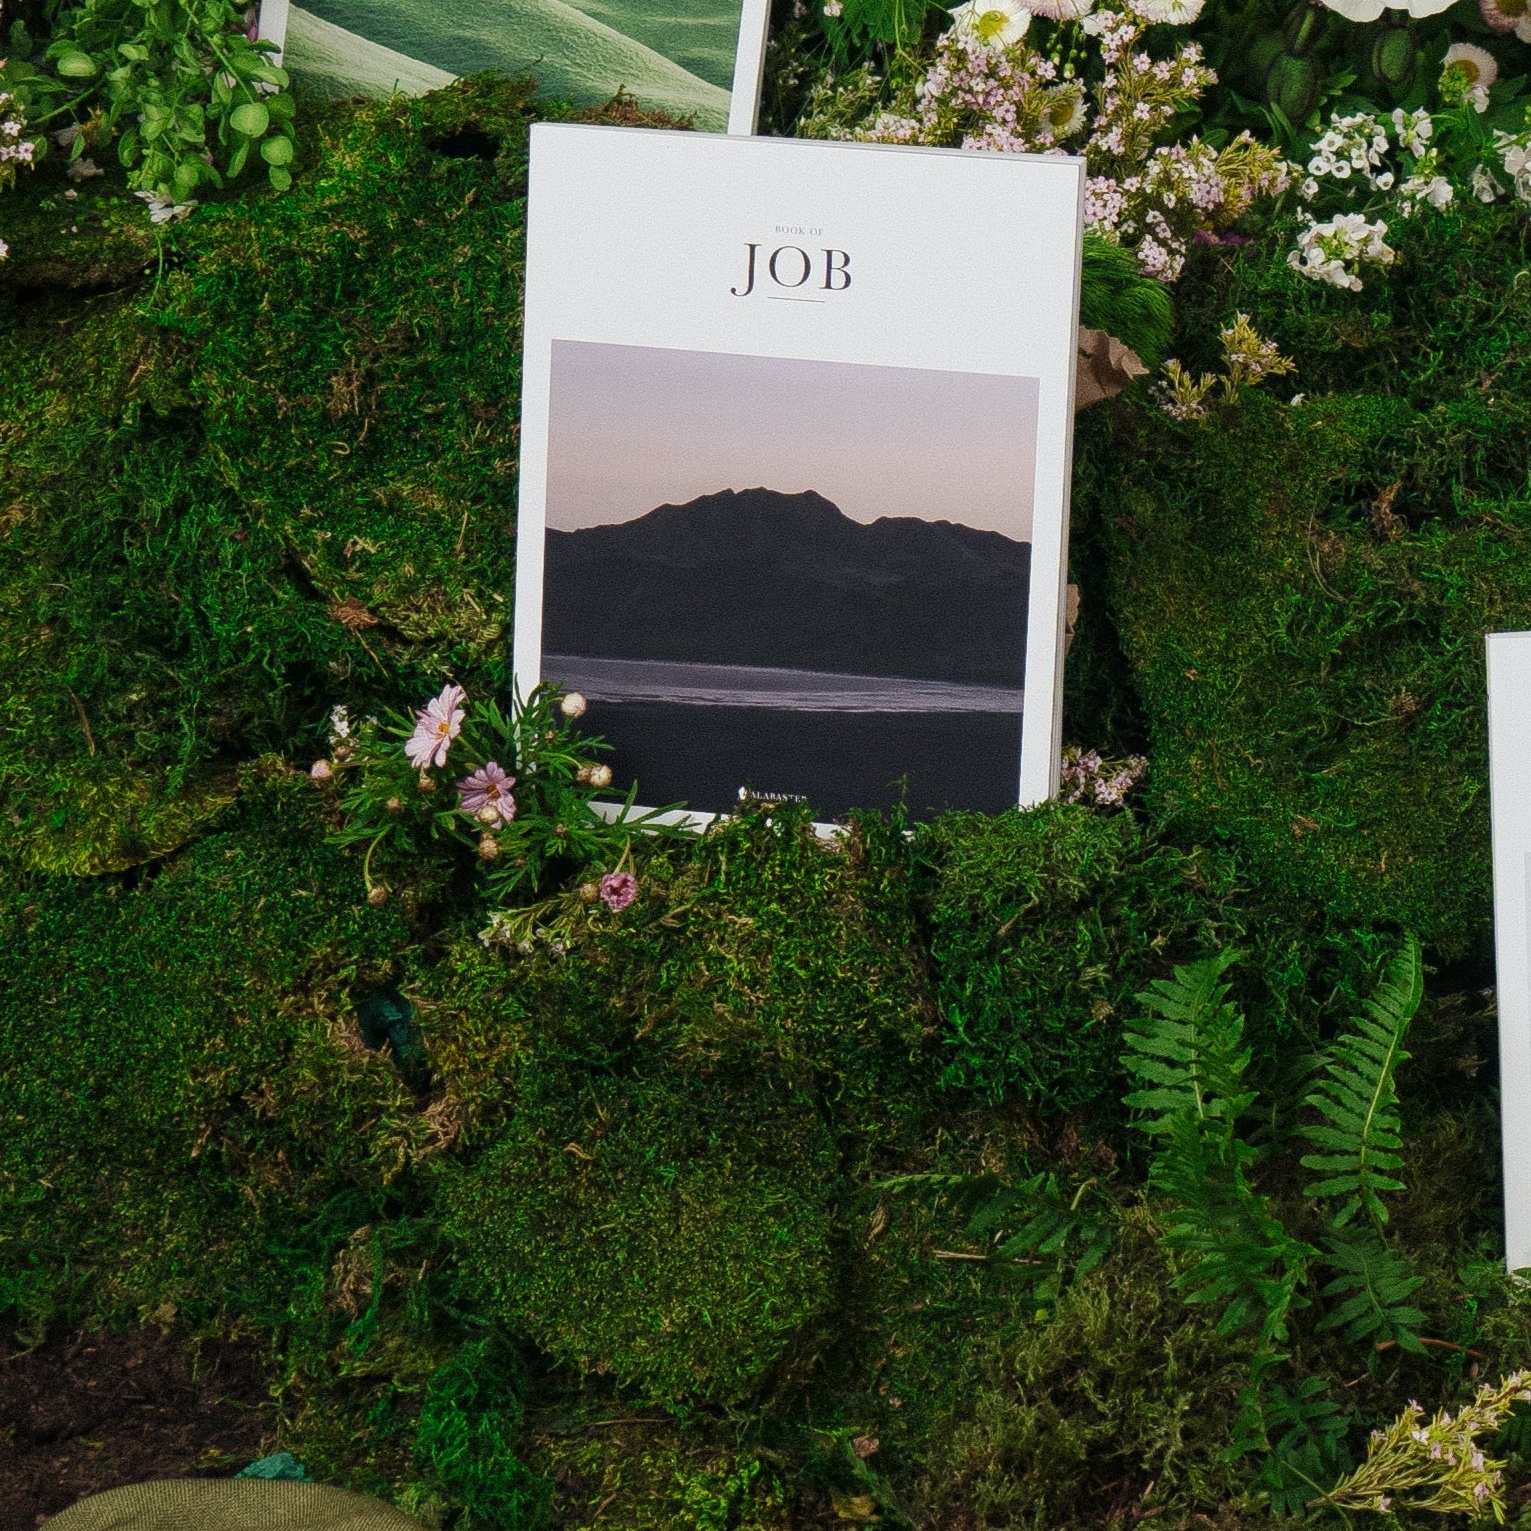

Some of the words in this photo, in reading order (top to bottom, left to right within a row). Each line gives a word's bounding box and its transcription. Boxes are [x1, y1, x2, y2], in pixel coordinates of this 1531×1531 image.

[775, 225, 806, 236] BOOK
[809, 228, 824, 237] OF
[730, 242, 852, 297] JOB
